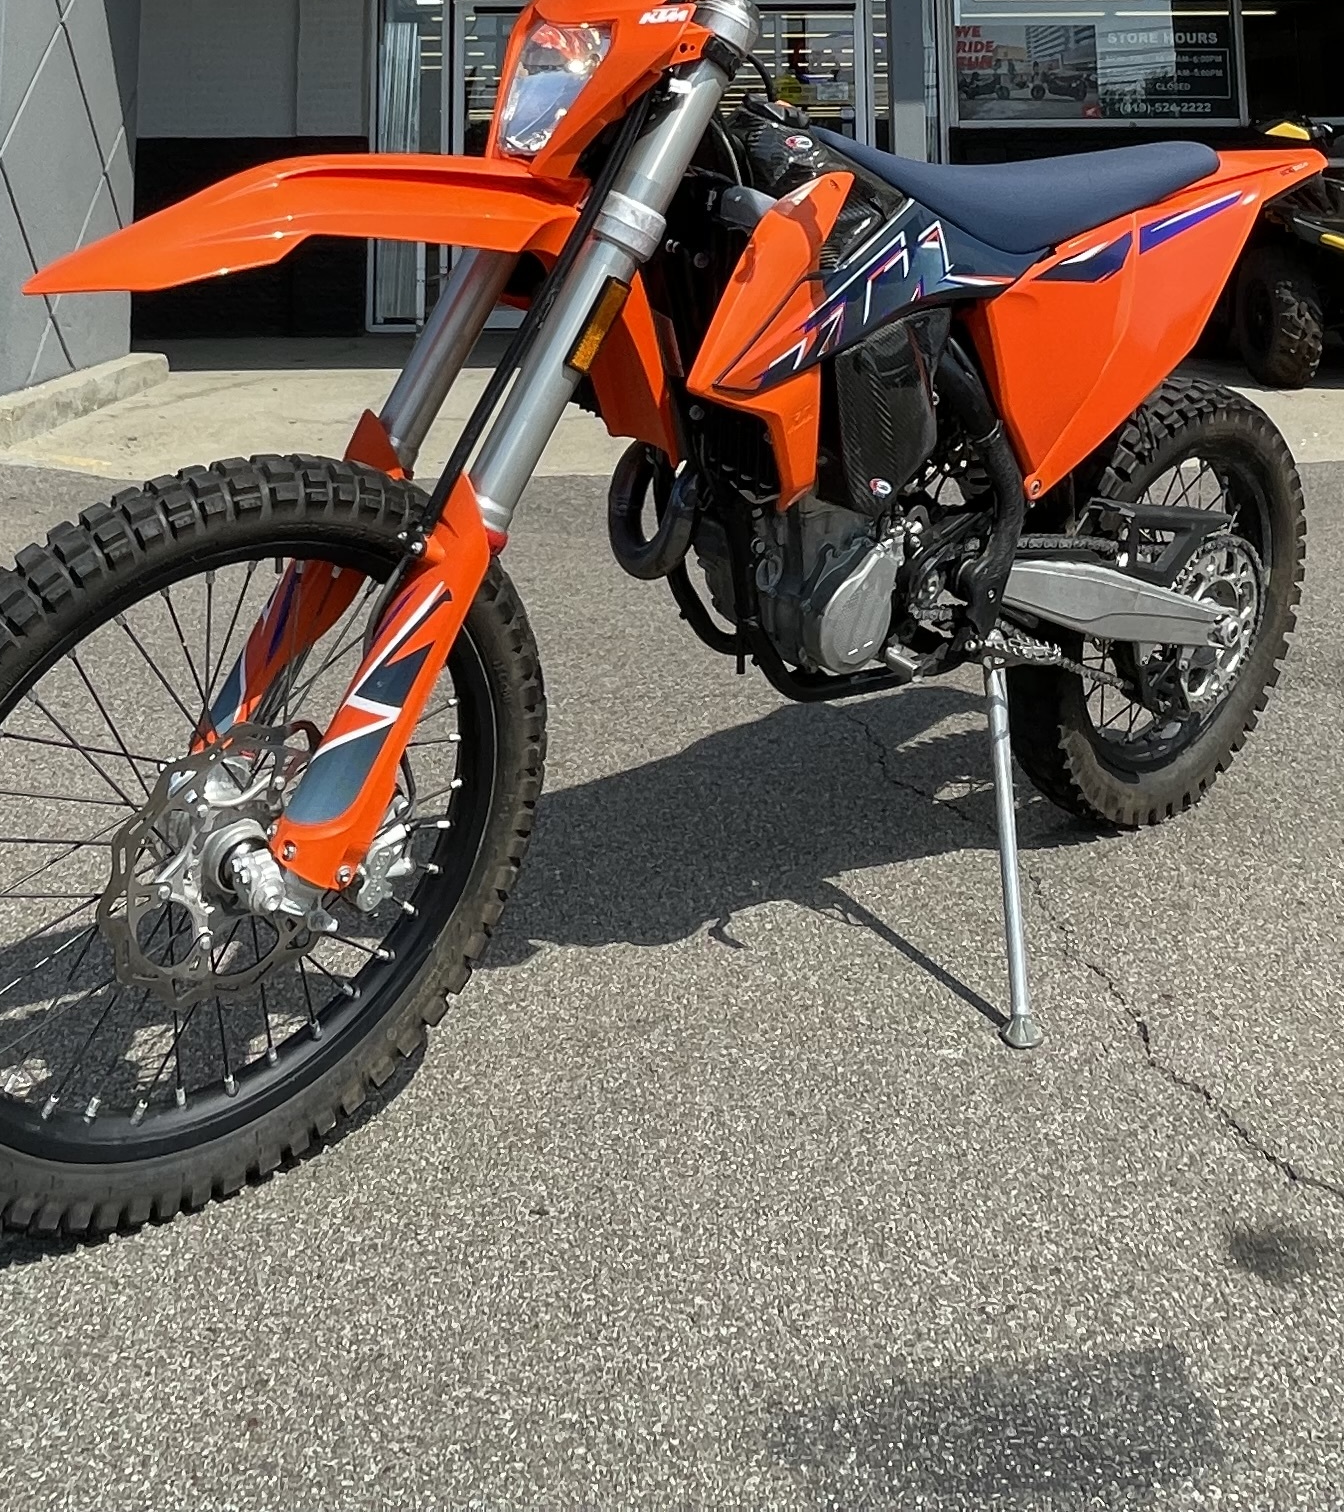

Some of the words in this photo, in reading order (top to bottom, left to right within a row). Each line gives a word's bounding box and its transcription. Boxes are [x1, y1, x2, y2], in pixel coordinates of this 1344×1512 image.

[639, 8, 689, 24] KTM
[1107, 33, 1158, 43] STORE
[1164, 32, 1218, 44] HOURS
[956, 41, 994, 53] RIDE
